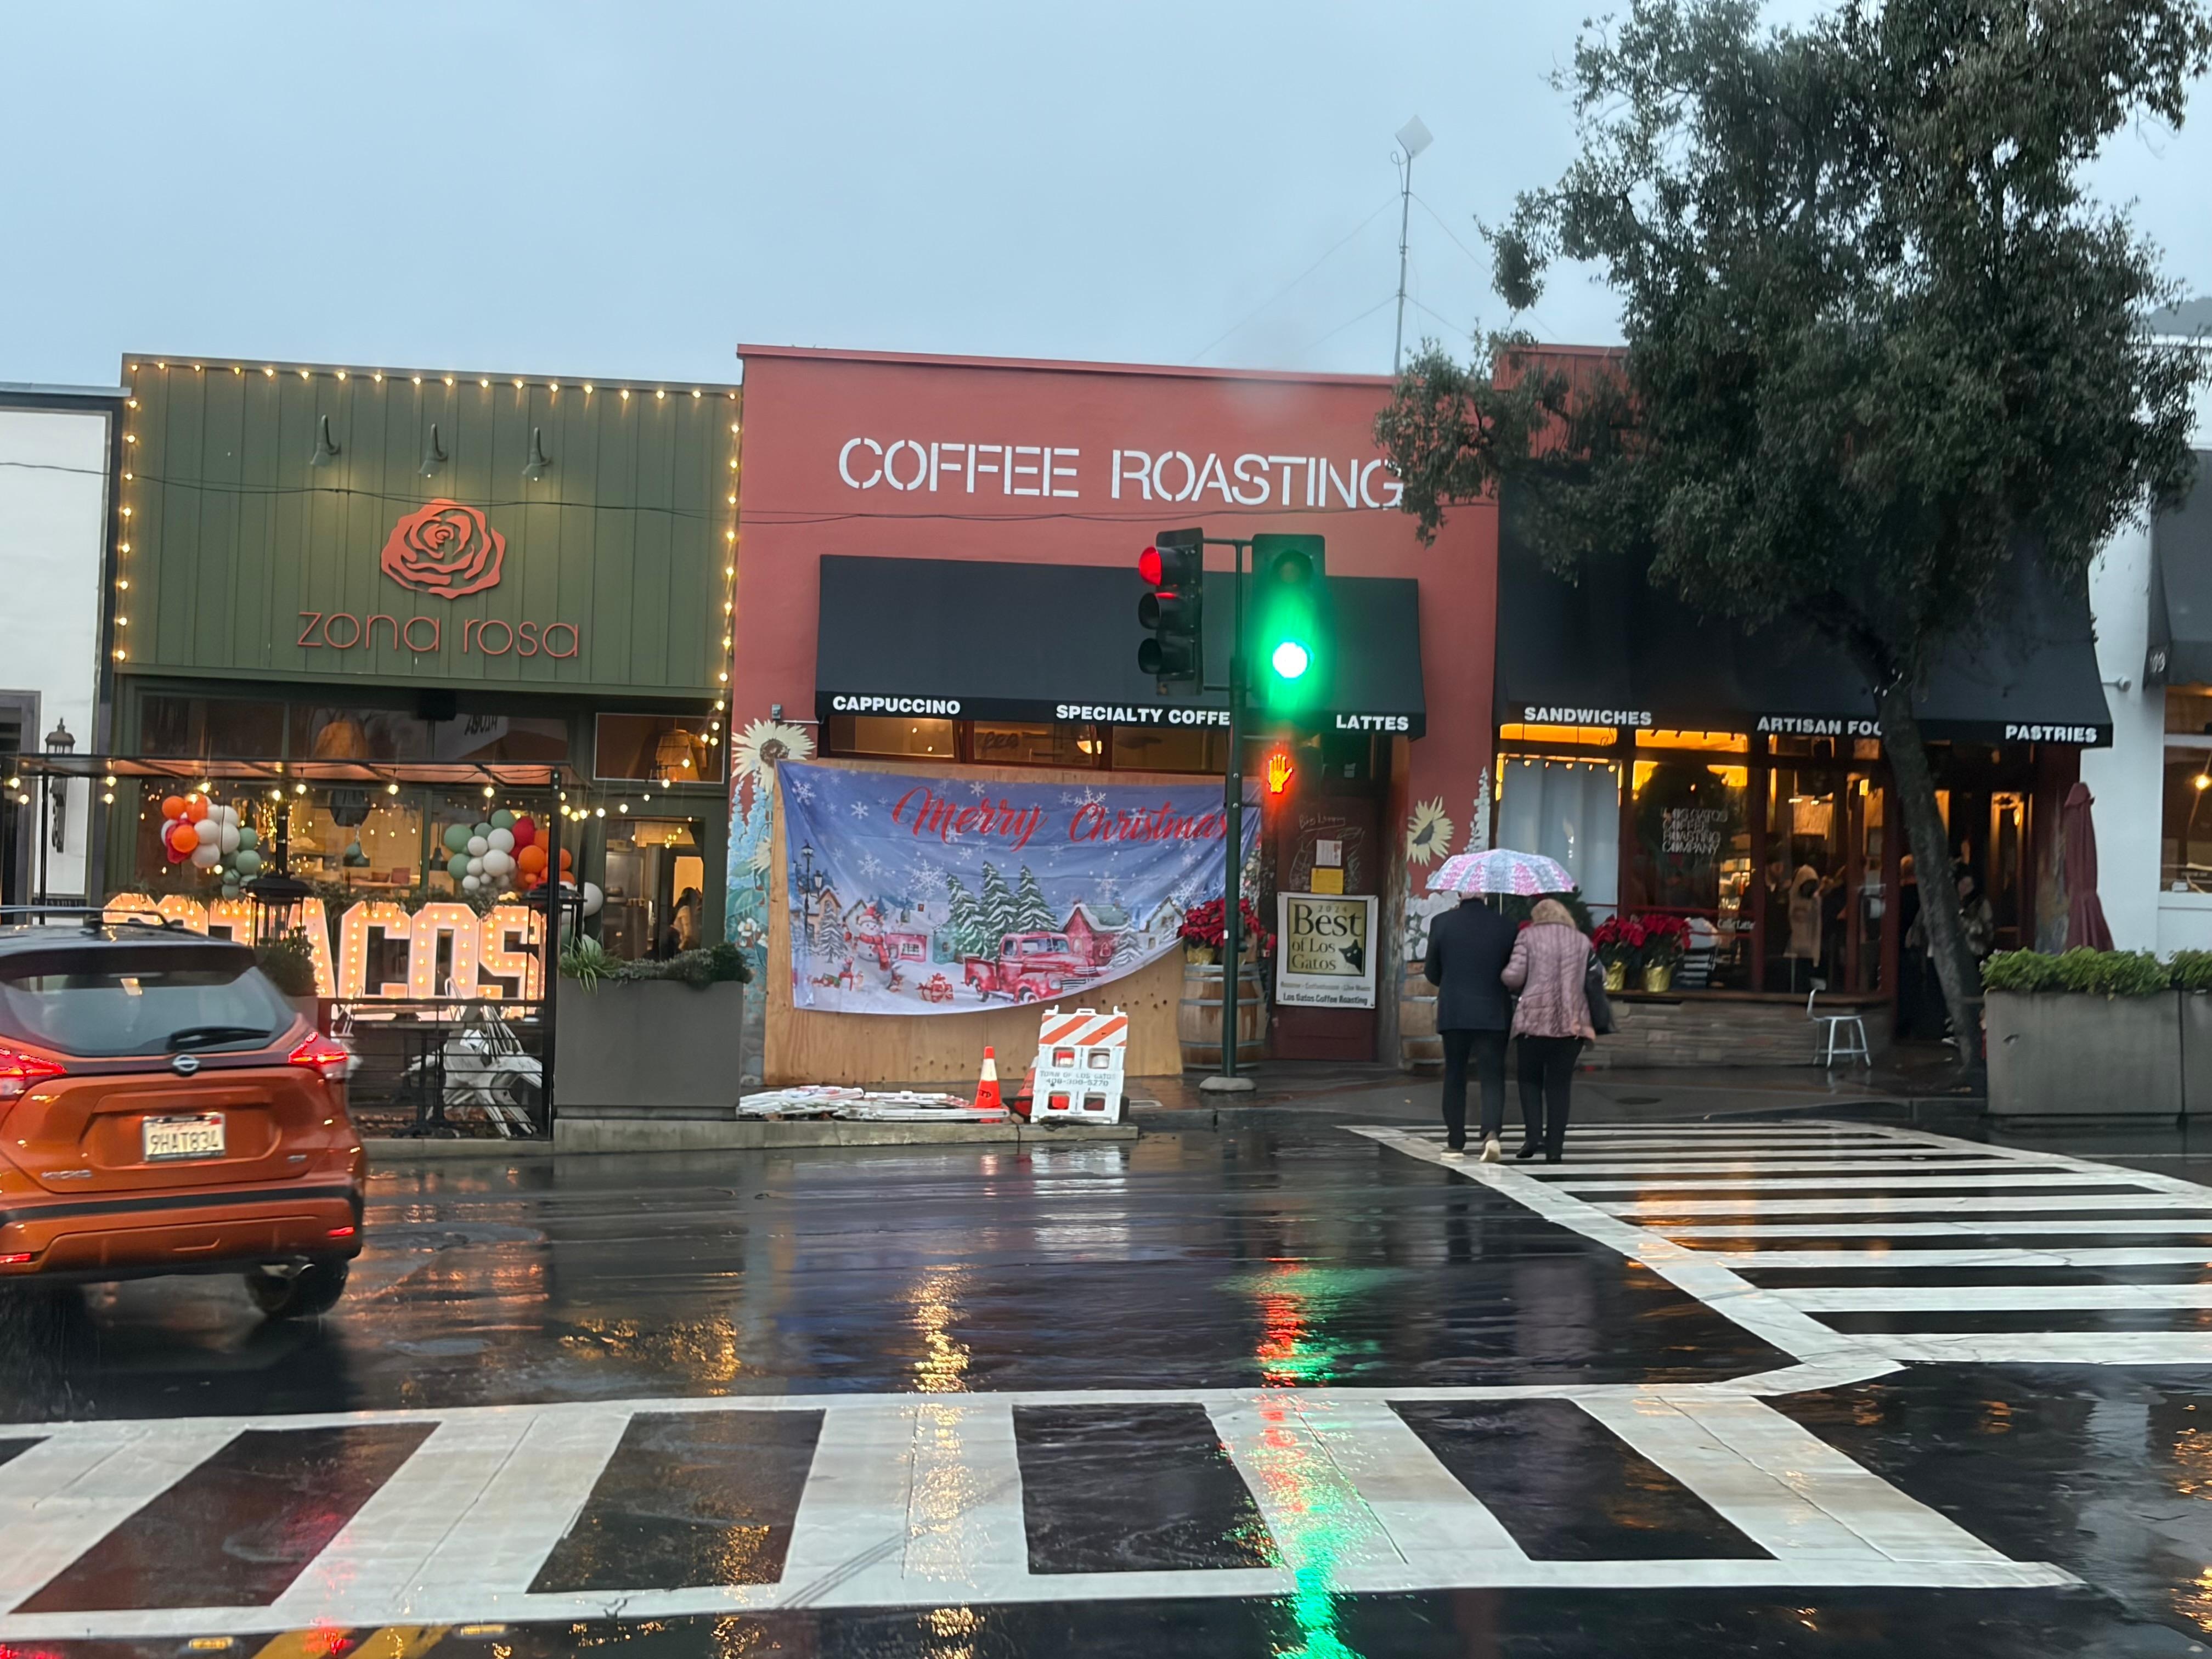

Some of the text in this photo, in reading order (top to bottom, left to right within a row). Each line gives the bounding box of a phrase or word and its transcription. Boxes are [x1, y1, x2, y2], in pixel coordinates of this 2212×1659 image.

[838, 437, 1404, 510] COFFEE ROASTING
[296, 612, 579, 659] zona rosa
[832, 695, 1409, 731] CAPPUCCINO SPECIALTY COFFE LATTES
[1523, 706, 1653, 726] SANDWICHES
[1757, 716, 1842, 735] ARTISAN
[2004, 724, 2098, 743] PASTRIES
[891, 785, 1229, 852] Merry Christmas
[1293, 904, 1363, 938] Best
[1318, 905, 1347, 913] 2024
[1291, 953, 1336, 970] Gatos
[1292, 938, 1335, 953] of Los
[1283, 992, 1295, 1001] Los
